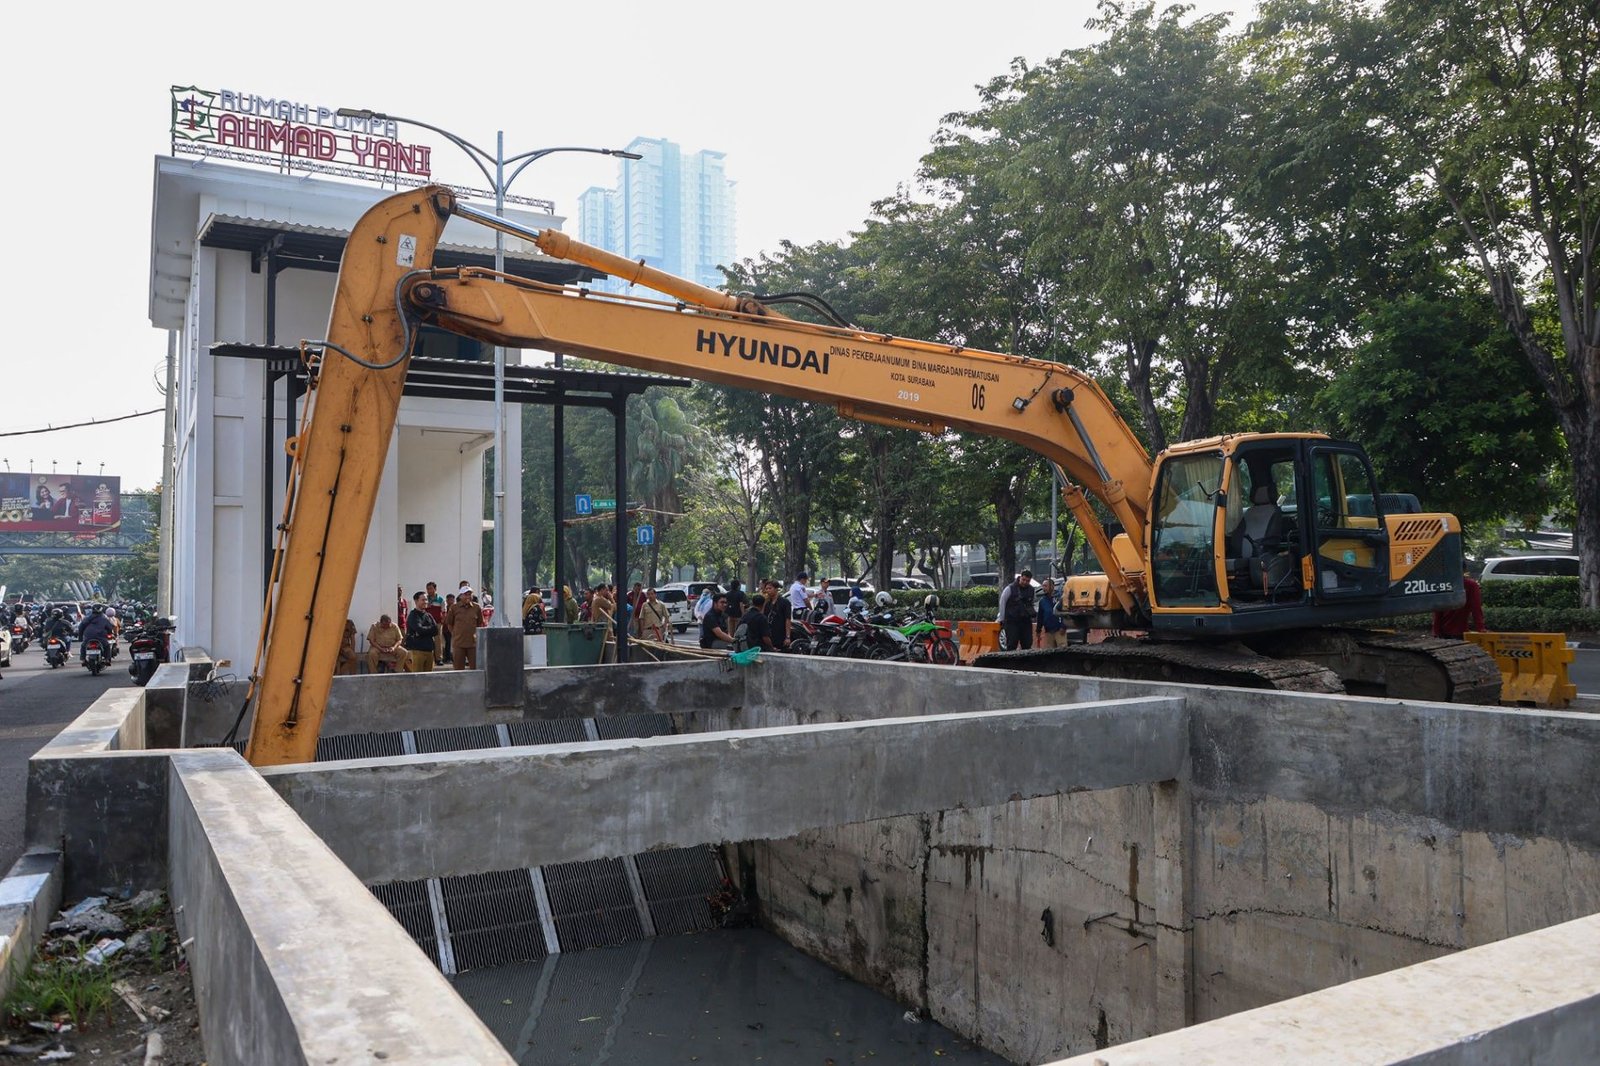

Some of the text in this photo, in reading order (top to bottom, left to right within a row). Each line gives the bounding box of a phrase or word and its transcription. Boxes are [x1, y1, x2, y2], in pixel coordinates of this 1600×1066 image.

[220, 88, 309, 124] RUMAH
[218, 113, 337, 161] AHMAD
[351, 134, 432, 177] YANI
[696, 328, 829, 375] HYUNDAI
[829, 345, 850, 358] DINAS
[912, 360, 927, 372] BINA
[928, 363, 950, 375] MARGA
[950, 367, 964, 377] DAN
[964, 368, 1000, 383] PEMATUSAN
[890, 372, 936, 388] KOTA SURABAYA
[897, 390, 920, 402] 2019
[971, 383, 986, 411] 06
